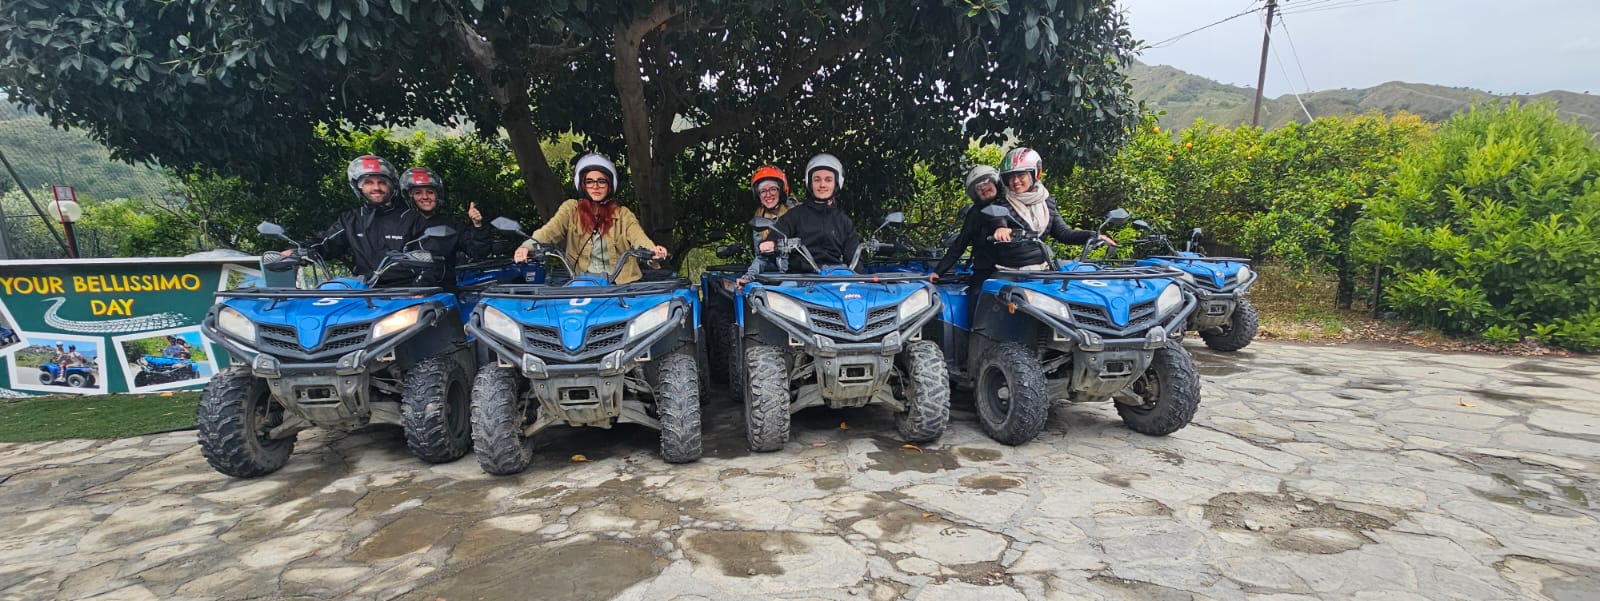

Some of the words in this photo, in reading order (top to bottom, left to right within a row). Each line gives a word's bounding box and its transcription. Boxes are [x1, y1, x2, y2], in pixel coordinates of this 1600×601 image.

[0, 276, 65, 295] YOUR
[73, 273, 201, 293] BELLISSIMO
[831, 282, 851, 292] 7
[91, 299, 134, 316] DAY
[311, 297, 344, 306] 5
